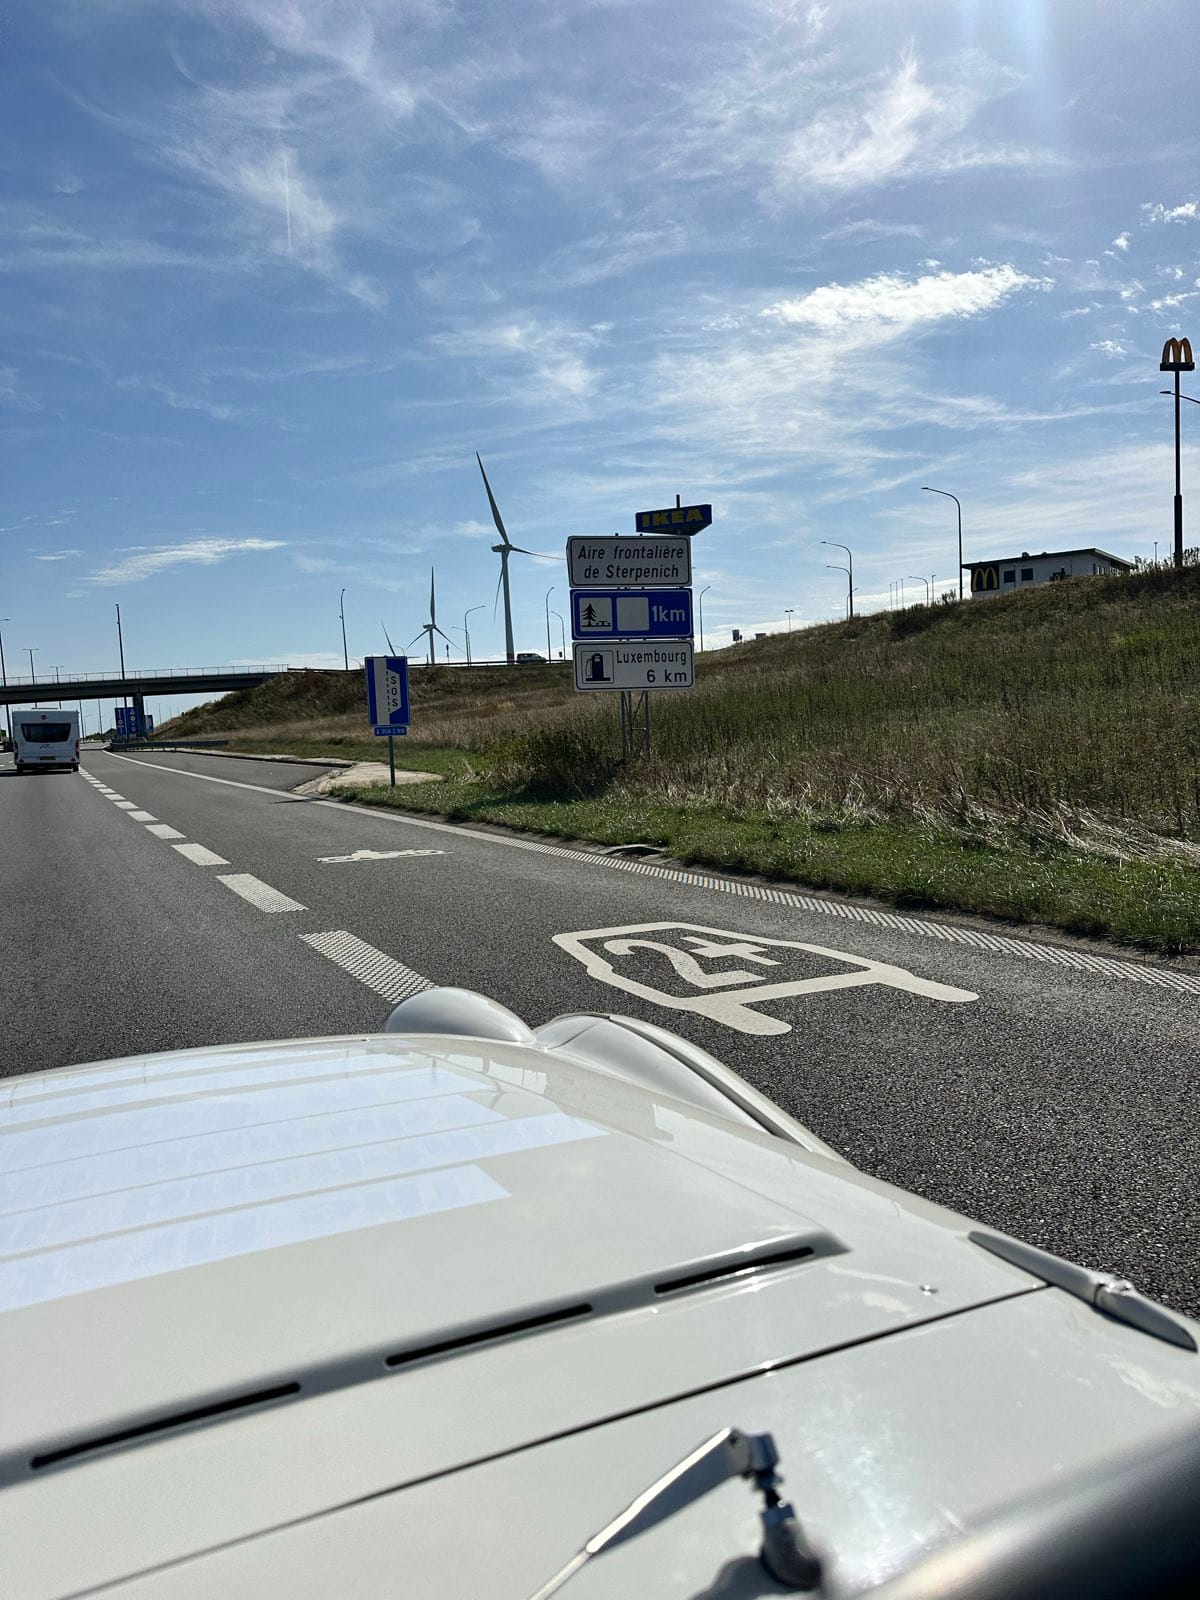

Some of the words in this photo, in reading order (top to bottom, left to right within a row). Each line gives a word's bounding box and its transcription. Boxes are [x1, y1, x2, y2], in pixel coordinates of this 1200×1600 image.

[642, 508, 703, 527] IKEA
[578, 545, 605, 560] Aire
[613, 544, 684, 560] frontalière
[584, 565, 600, 579] de
[606, 563, 679, 581] Sterpenich
[652, 605, 686, 622] 1km
[616, 649, 687, 665] Luxembourg
[646, 671, 656, 683] 6
[664, 670, 687, 683] km
[390, 676, 398, 707] SOS
